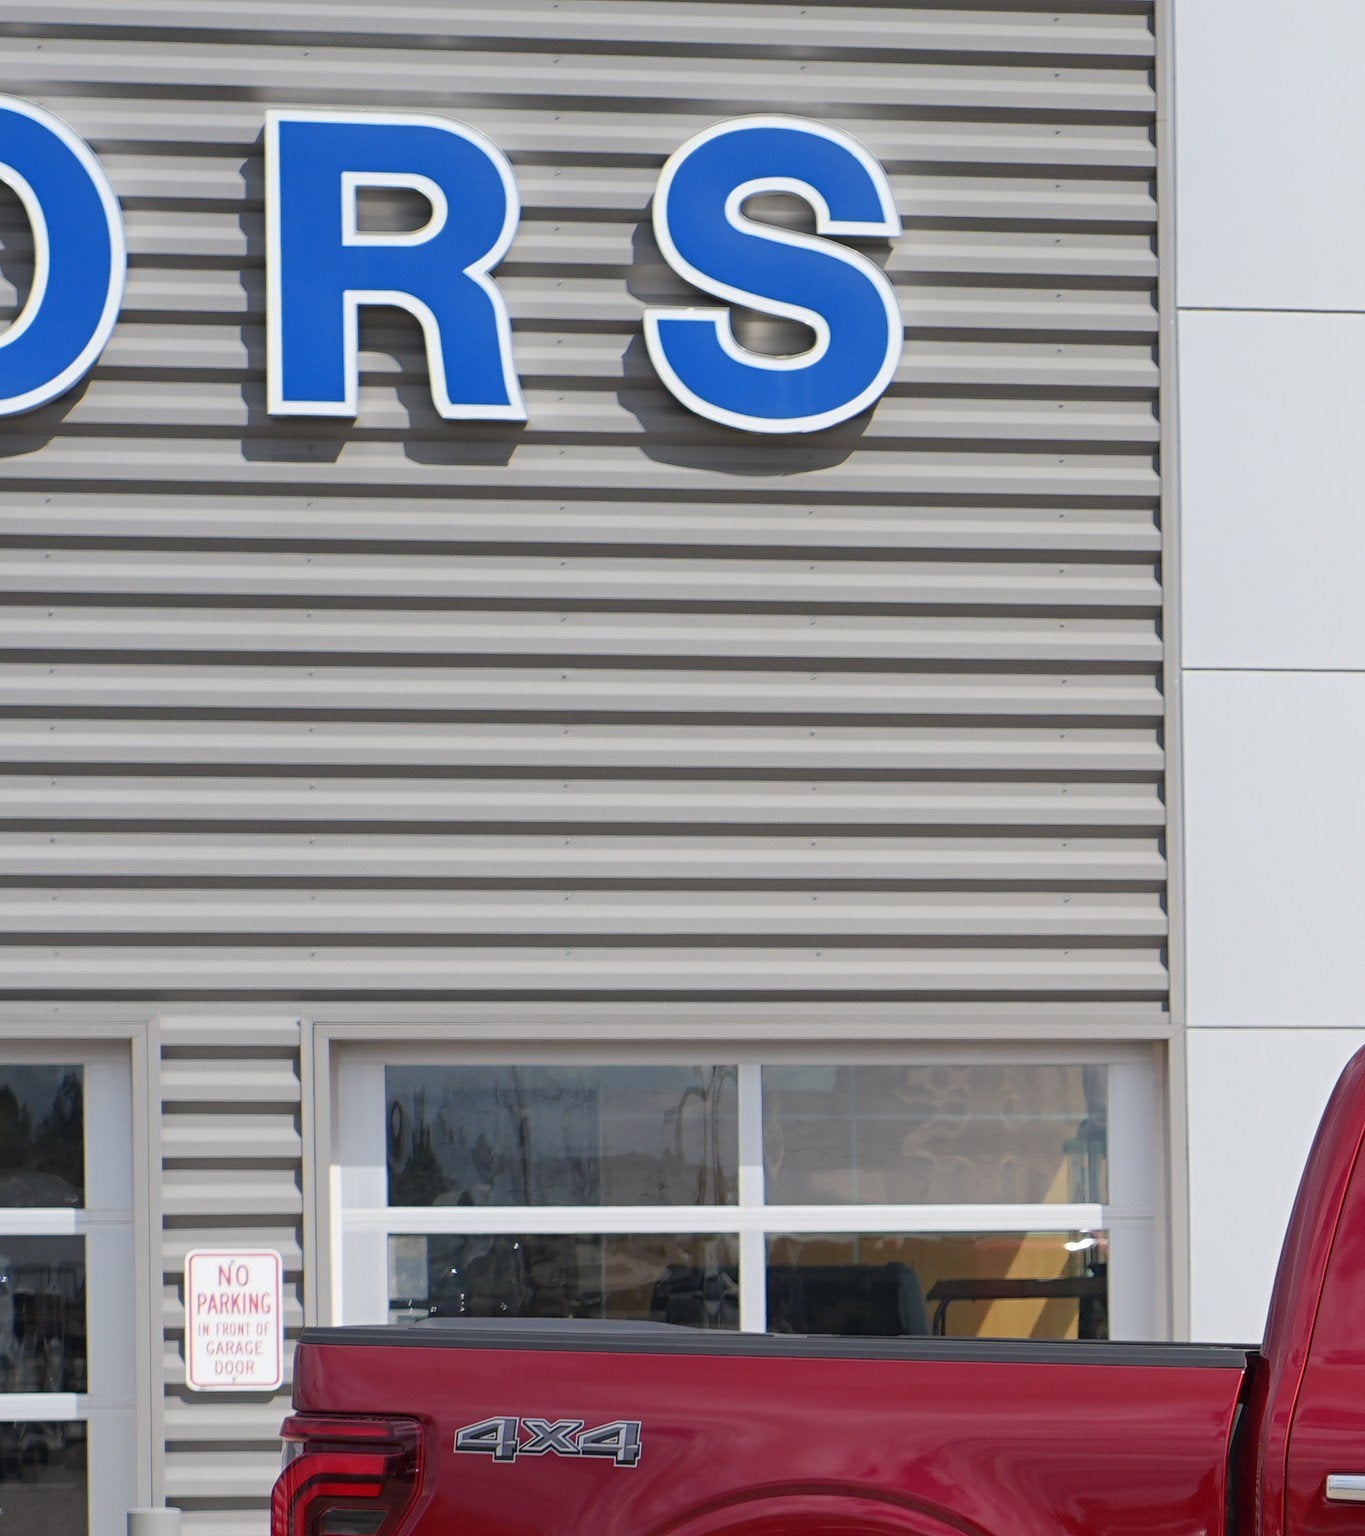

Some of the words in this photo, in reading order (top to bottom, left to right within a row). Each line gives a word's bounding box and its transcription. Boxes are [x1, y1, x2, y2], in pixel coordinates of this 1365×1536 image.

[218, 1264, 249, 1287] NO
[197, 1293, 271, 1314] PARKING
[198, 1322, 209, 1335] IN
[215, 1322, 250, 1336] FRONT
[256, 1322, 270, 1335] OF
[206, 1341, 263, 1356] GARAGE
[214, 1360, 255, 1375] DOOR
